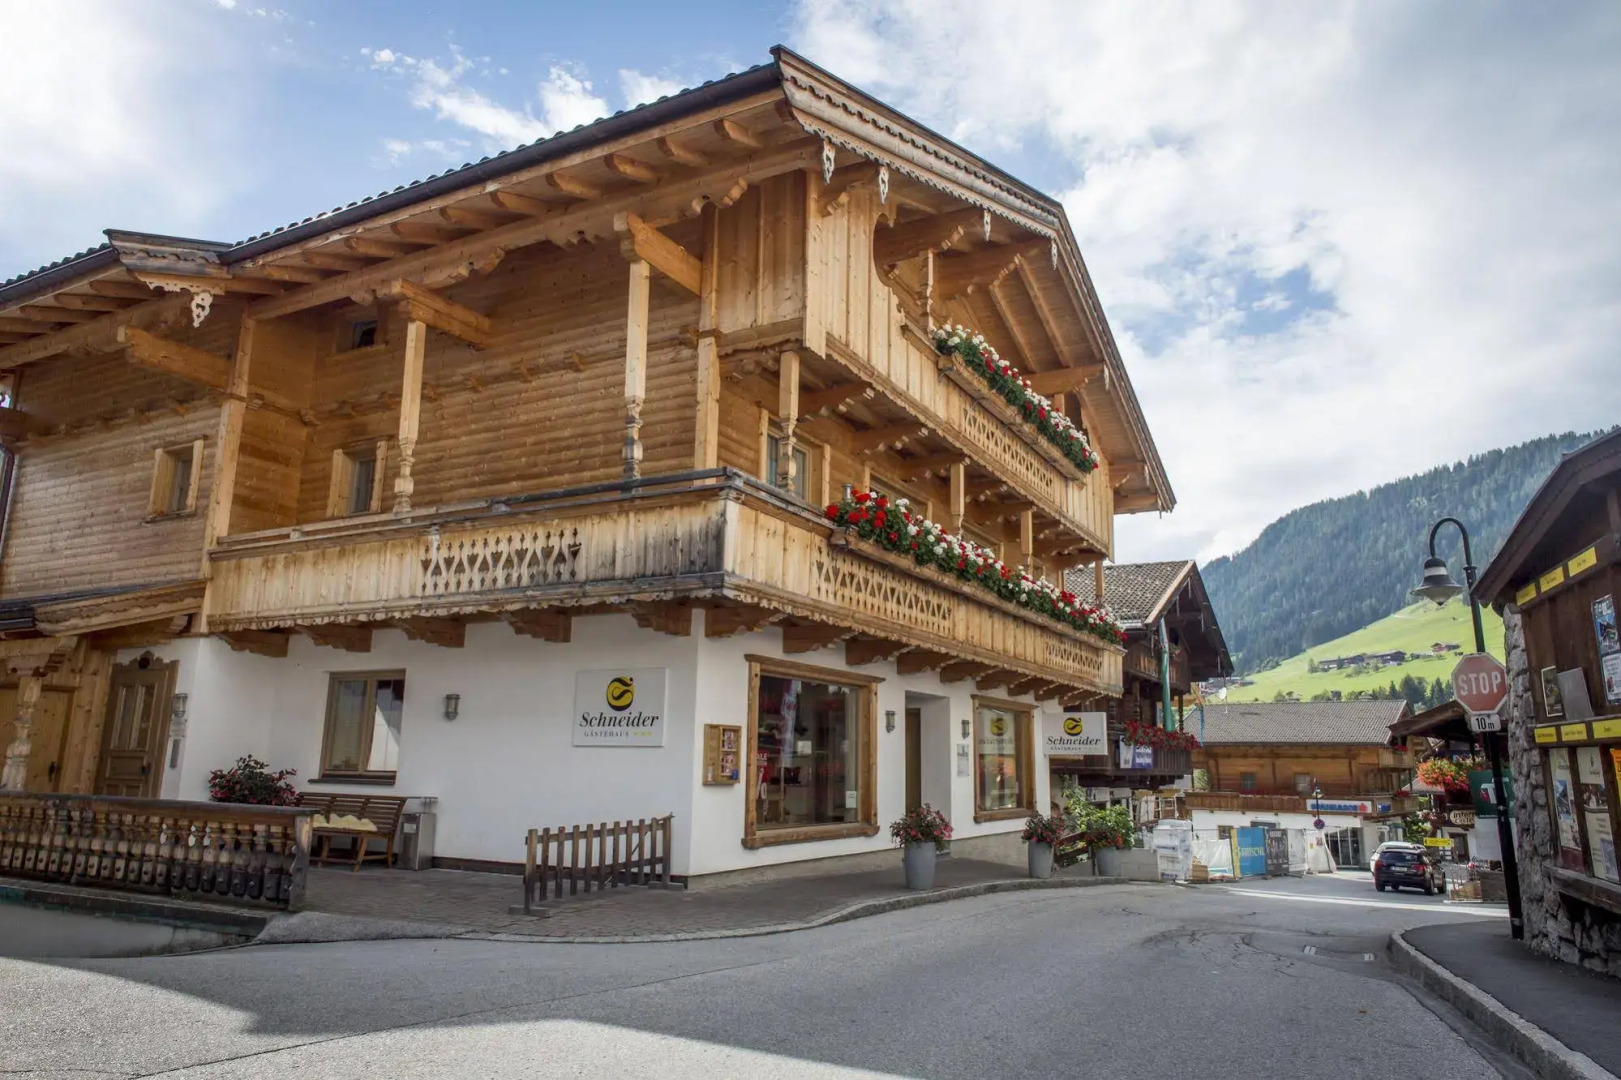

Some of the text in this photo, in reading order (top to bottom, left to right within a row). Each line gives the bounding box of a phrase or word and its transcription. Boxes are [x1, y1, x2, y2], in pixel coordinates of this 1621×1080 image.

[1458, 671, 1501, 696] STOP
[579, 711, 659, 728] Schneider
[1475, 716, 1487, 730] 10
[1046, 735, 1102, 746] Schneider
